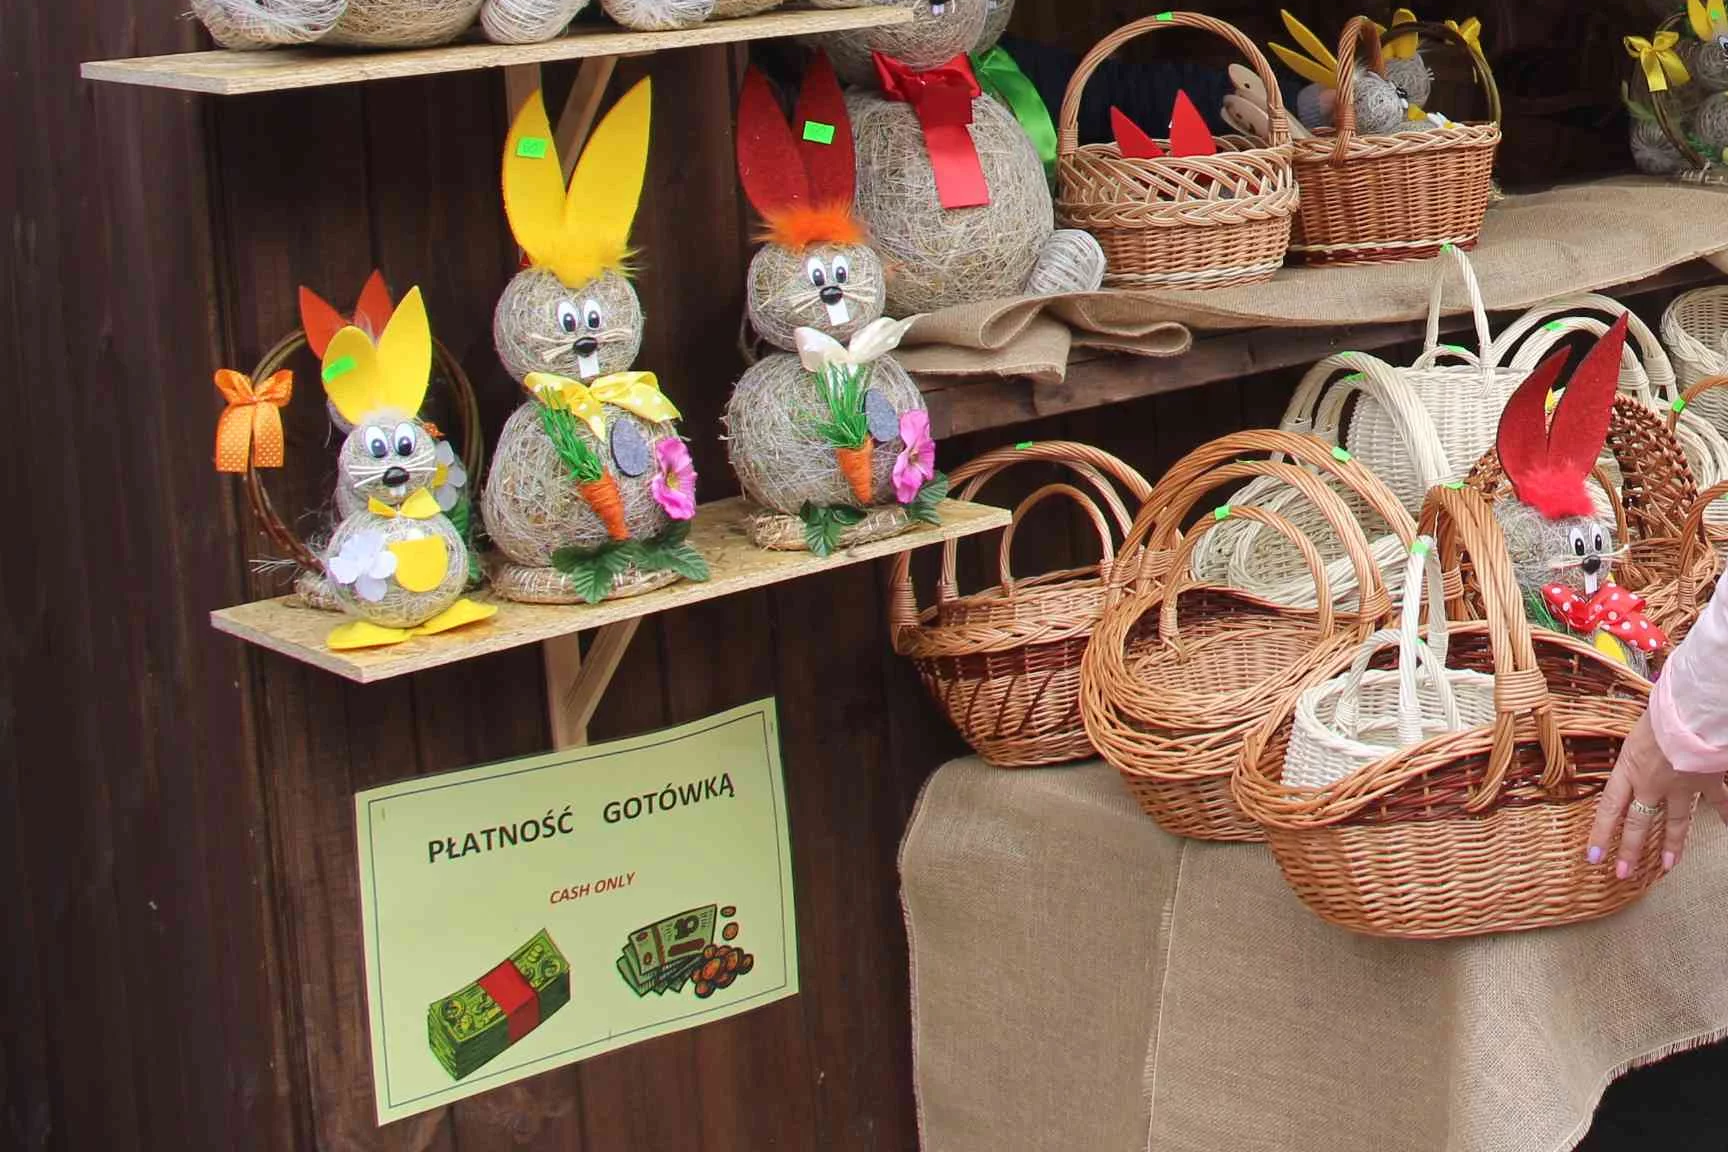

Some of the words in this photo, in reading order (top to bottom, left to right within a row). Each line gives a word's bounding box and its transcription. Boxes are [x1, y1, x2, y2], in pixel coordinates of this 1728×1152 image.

[428, 805, 574, 864] PŁATNOŚĆ
[602, 772, 736, 824] GOTÓWKĄ
[549, 883, 591, 904] CASH
[593, 871, 636, 894] ONLY
